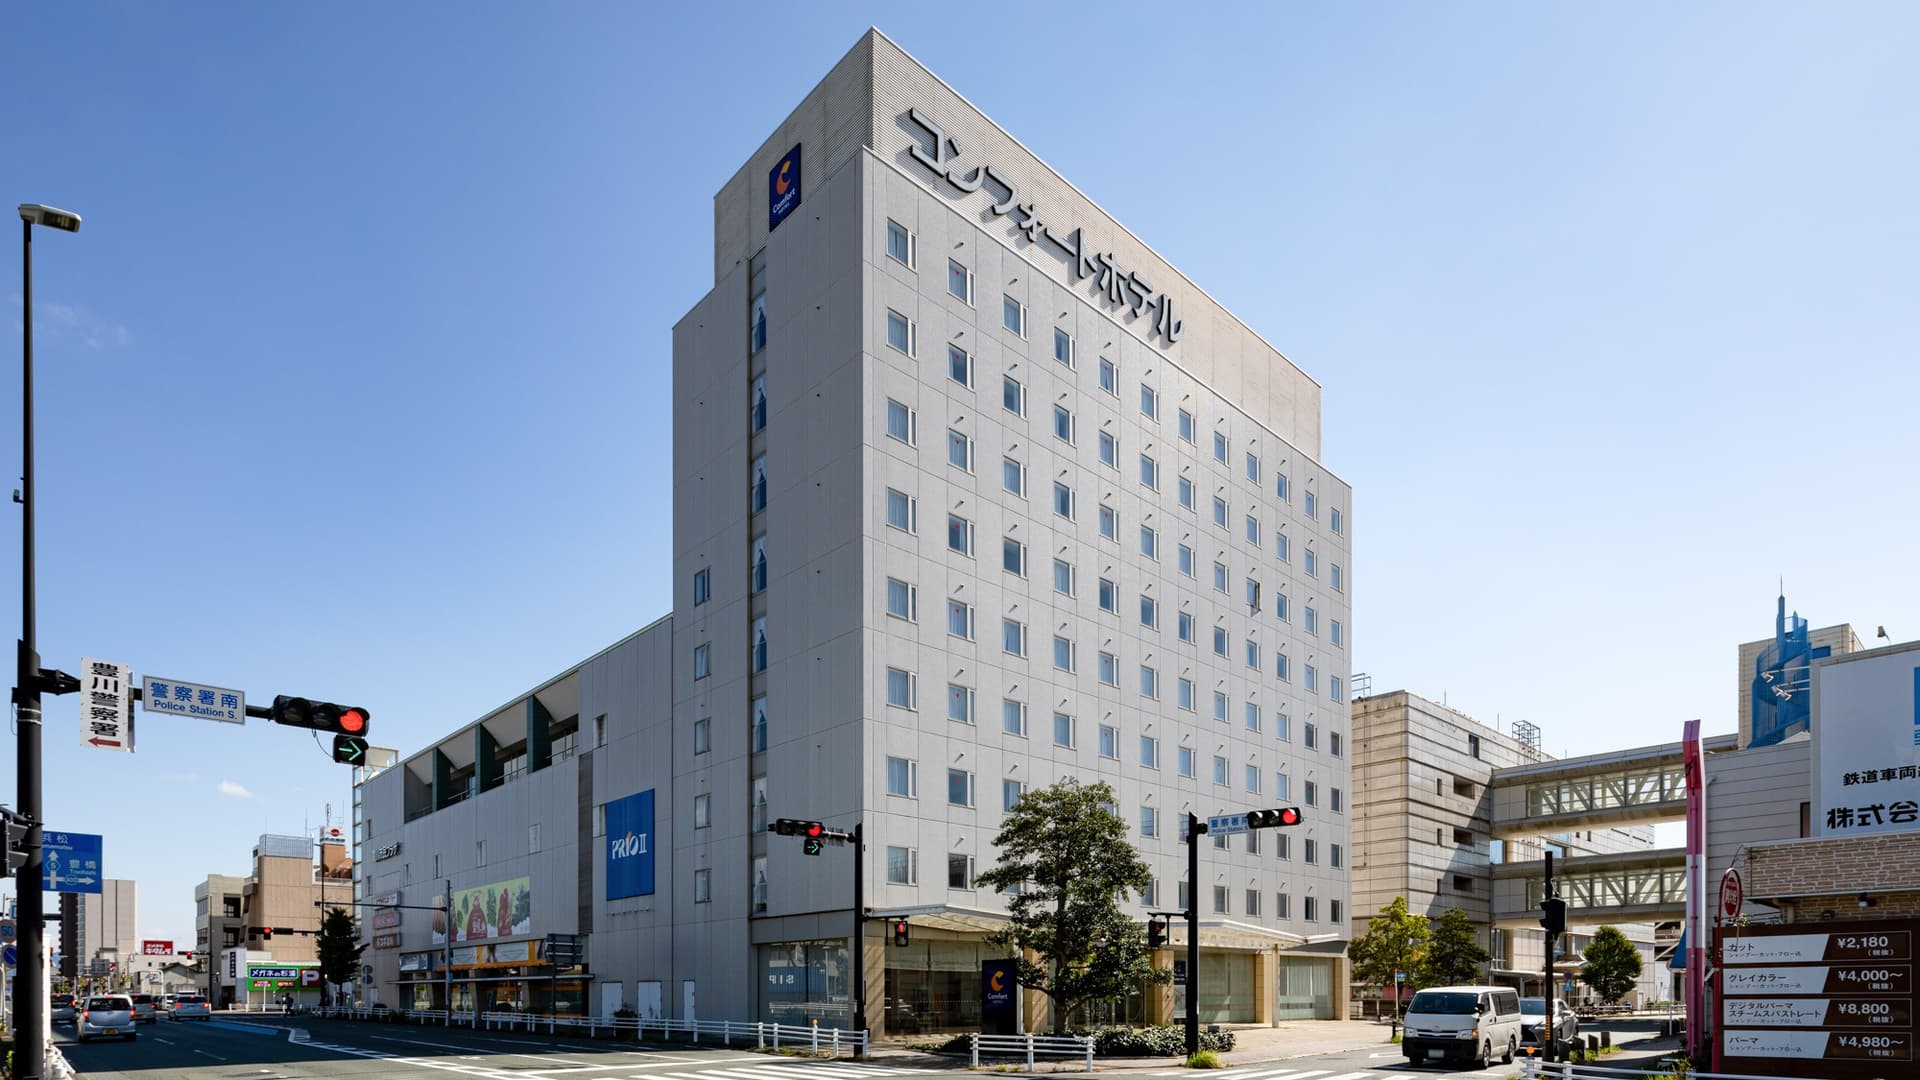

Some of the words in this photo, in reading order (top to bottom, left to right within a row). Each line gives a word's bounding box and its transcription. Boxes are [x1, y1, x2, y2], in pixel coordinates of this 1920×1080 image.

[772, 187, 796, 214] Comfort
[909, 107, 1184, 343] コンフォートホテル
[90, 662, 119, 737] 豊川警察署
[150, 682, 239, 710] 警察署南
[153, 699, 186, 712] Police
[189, 704, 224, 718] Station
[227, 711, 238, 720] S.
[1843, 765, 1920, 786] 鉄道車両
[1827, 800, 1919, 829] 株式会
[1, 925, 14, 937] 50
[1728, 943, 1755, 952] カット
[1837, 936, 1888, 949] ¥2,180
[301, 970, 320, 986] P
[1728, 973, 1787, 983] グレイカラー
[987, 992, 1009, 1001] Comfort
[1728, 1002, 1793, 1010] デジタルパーマ
[1838, 1003, 1889, 1016] ¥8,800
